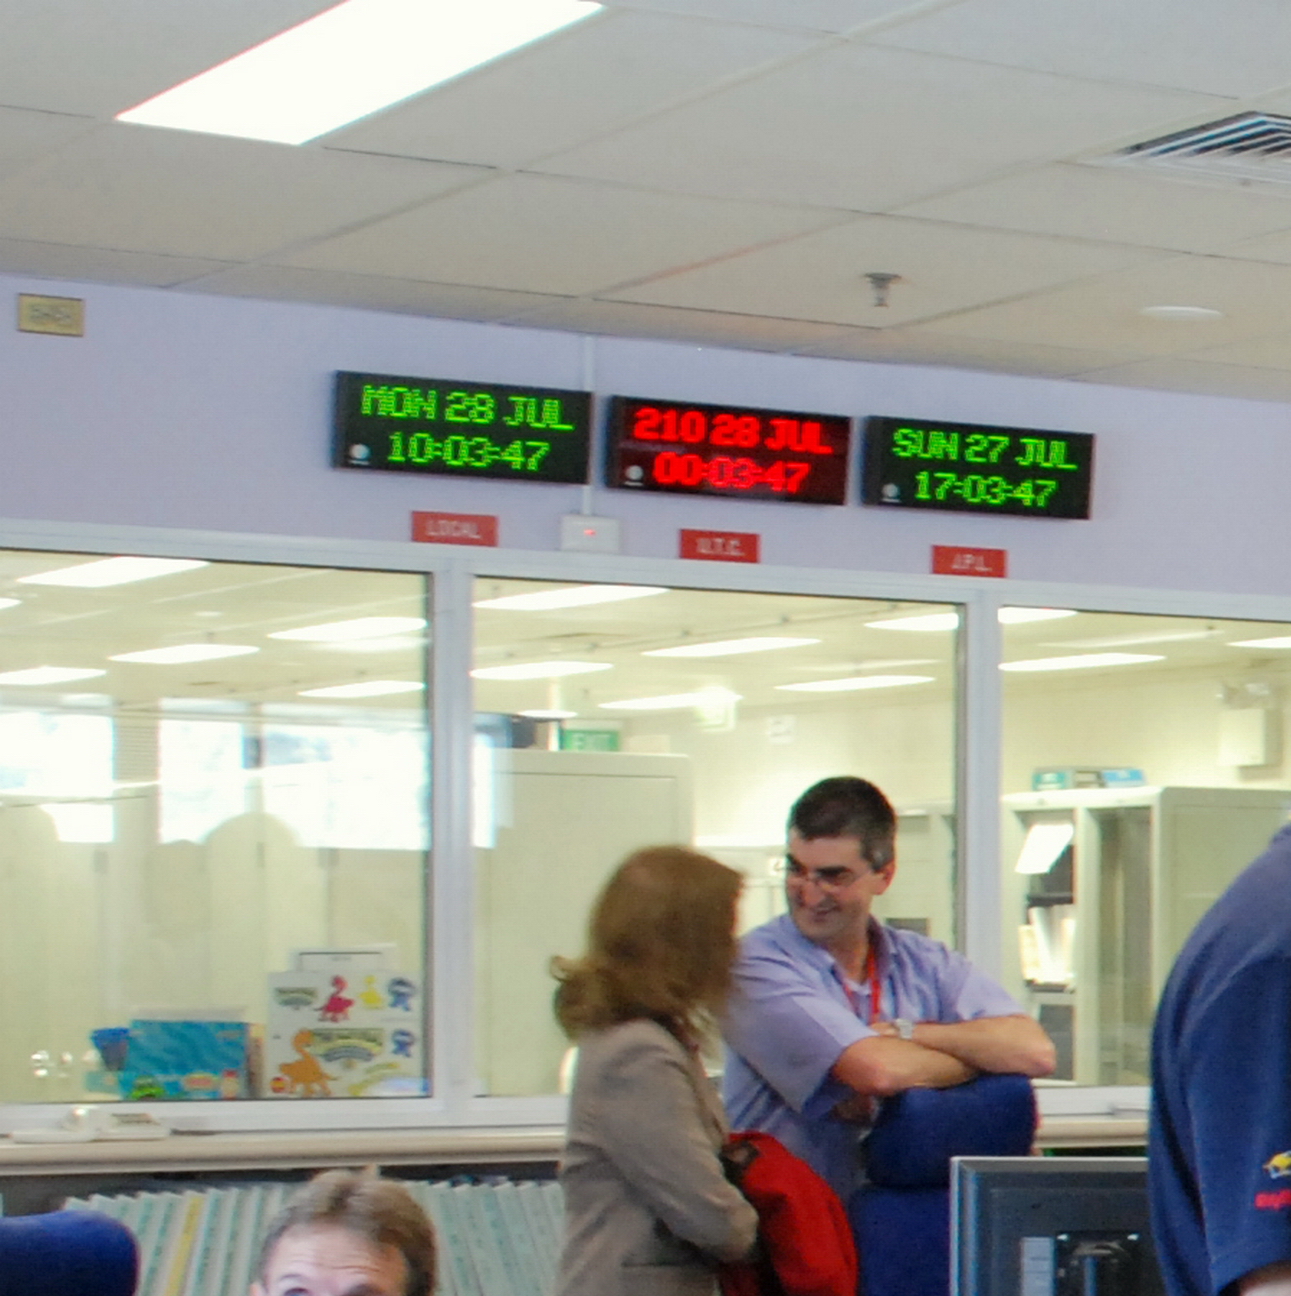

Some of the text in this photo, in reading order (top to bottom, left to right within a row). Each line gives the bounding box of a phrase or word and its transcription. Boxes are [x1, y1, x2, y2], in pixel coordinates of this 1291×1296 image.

[360, 384, 576, 432] MON 28 JUL
[388, 431, 551, 471] 10:03:47
[633, 407, 835, 455] 210 28 JUL
[892, 427, 1078, 470] SUN 27 JUL
[653, 451, 811, 494] 00:03:47
[914, 470, 1058, 507] 17:03:47
[425, 519, 482, 539] LOCAL
